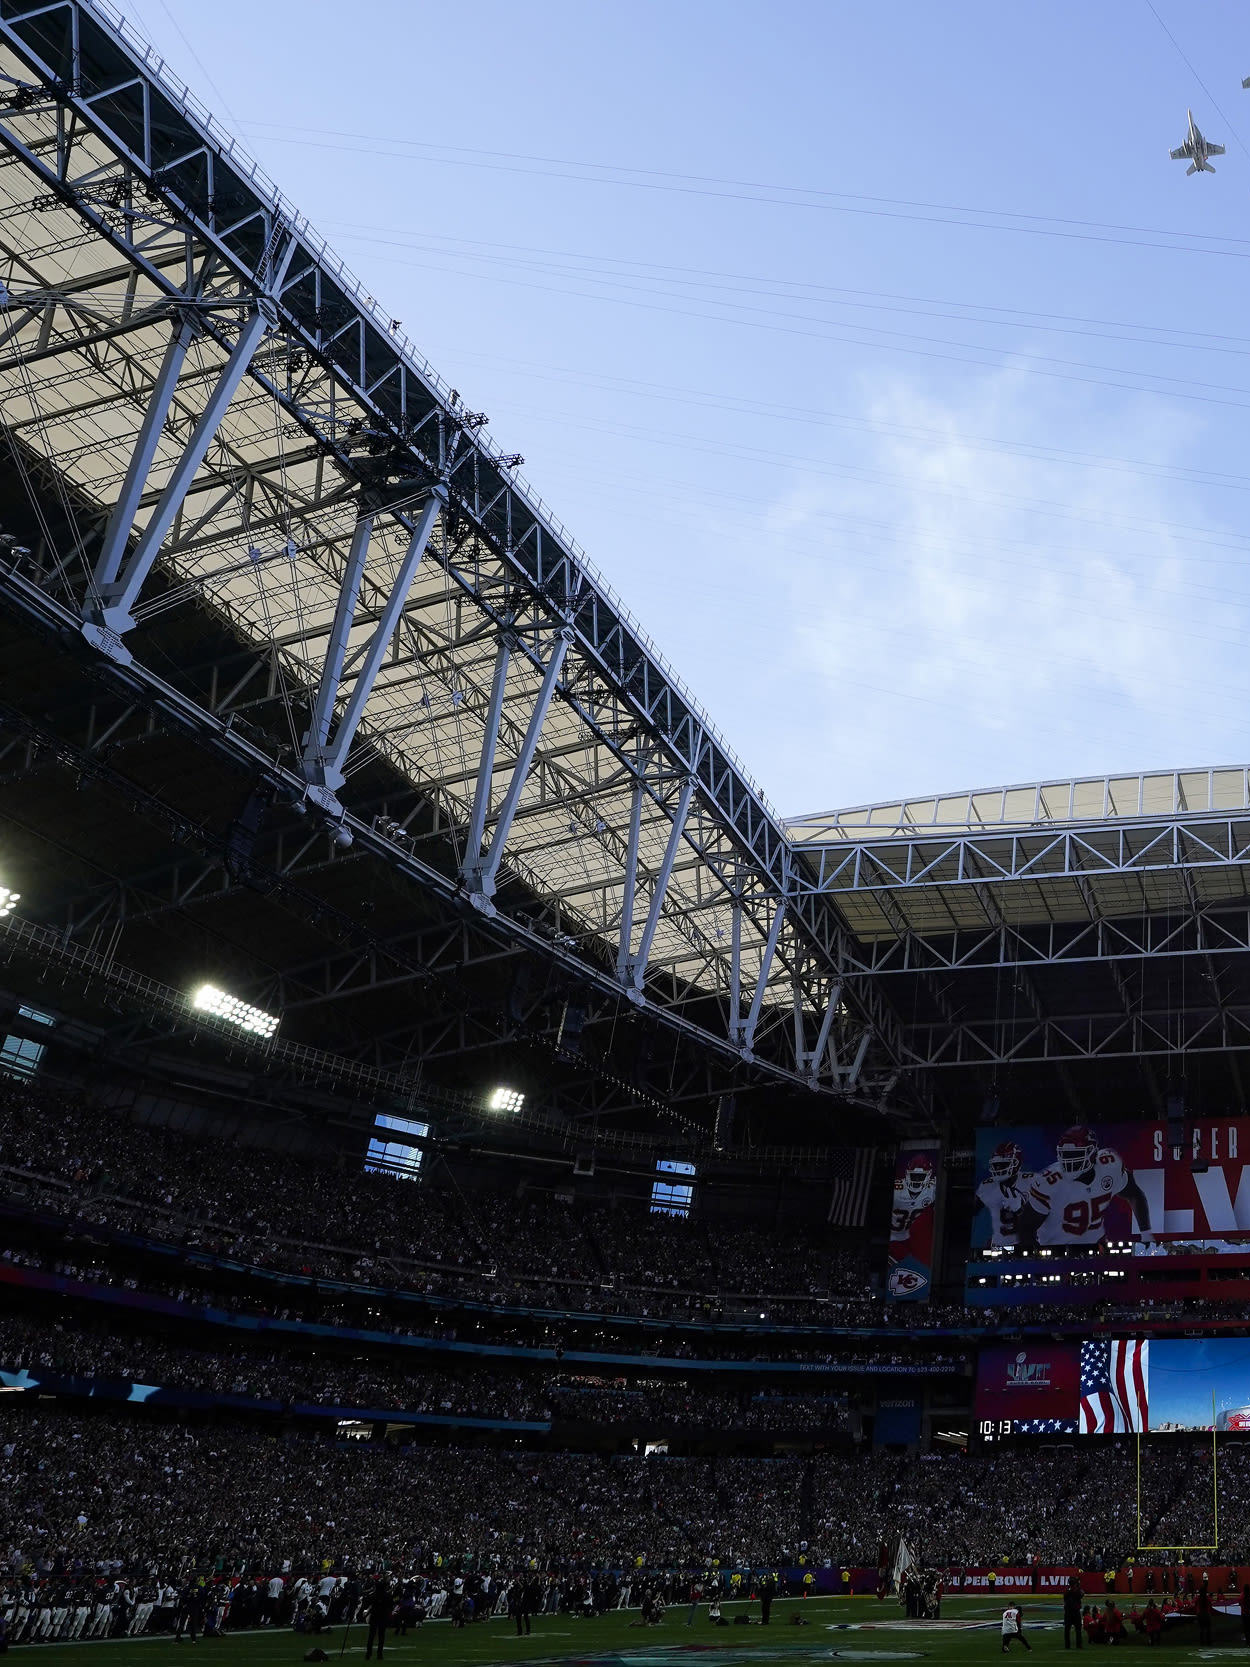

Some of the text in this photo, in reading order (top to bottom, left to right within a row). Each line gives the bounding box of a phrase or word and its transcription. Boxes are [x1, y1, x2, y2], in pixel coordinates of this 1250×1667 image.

[1062, 1192, 1113, 1236] 95
[897, 1273, 918, 1289] KC
[880, 1400, 914, 1408] verizon
[980, 1420, 1011, 1434] 10:13
